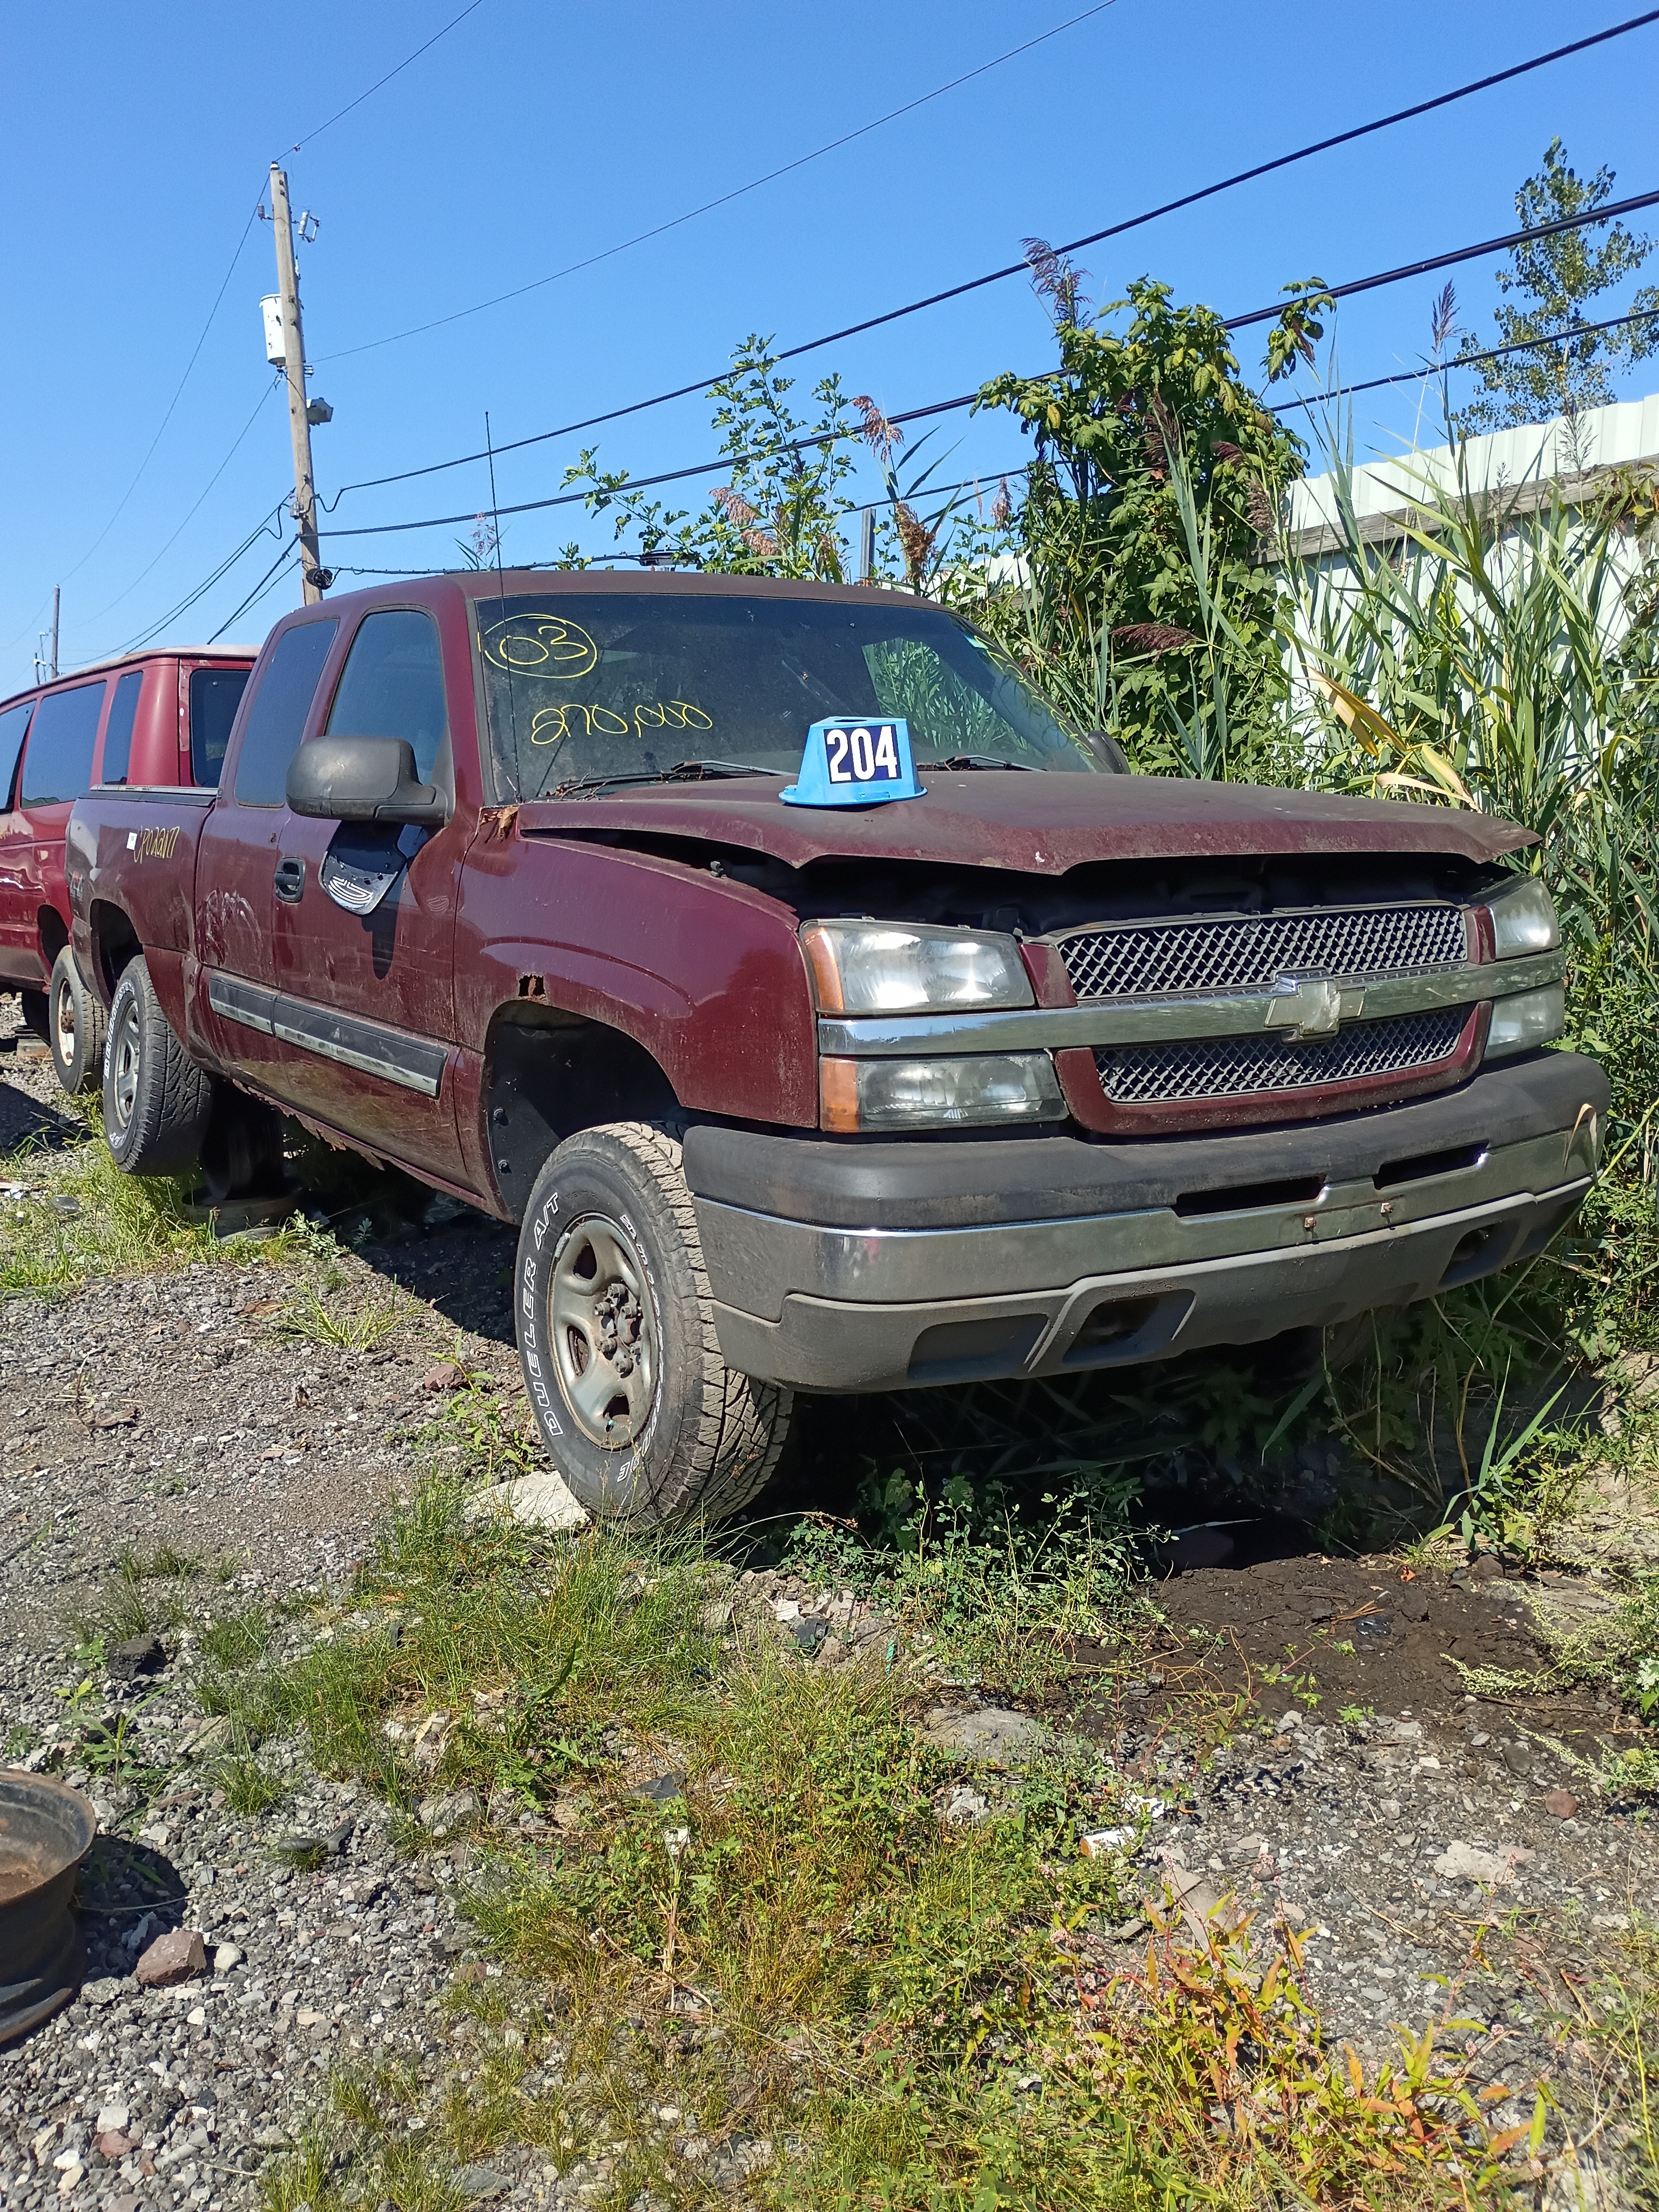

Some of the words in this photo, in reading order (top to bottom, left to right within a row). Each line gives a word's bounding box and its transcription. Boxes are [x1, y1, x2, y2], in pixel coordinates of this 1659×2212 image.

[499, 625, 589, 665] 03
[531, 700, 713, 745] 270,000
[827, 726, 898, 782] 204
[534, 1192, 559, 1251] A/T
[523, 1257, 564, 1437] DUELER
